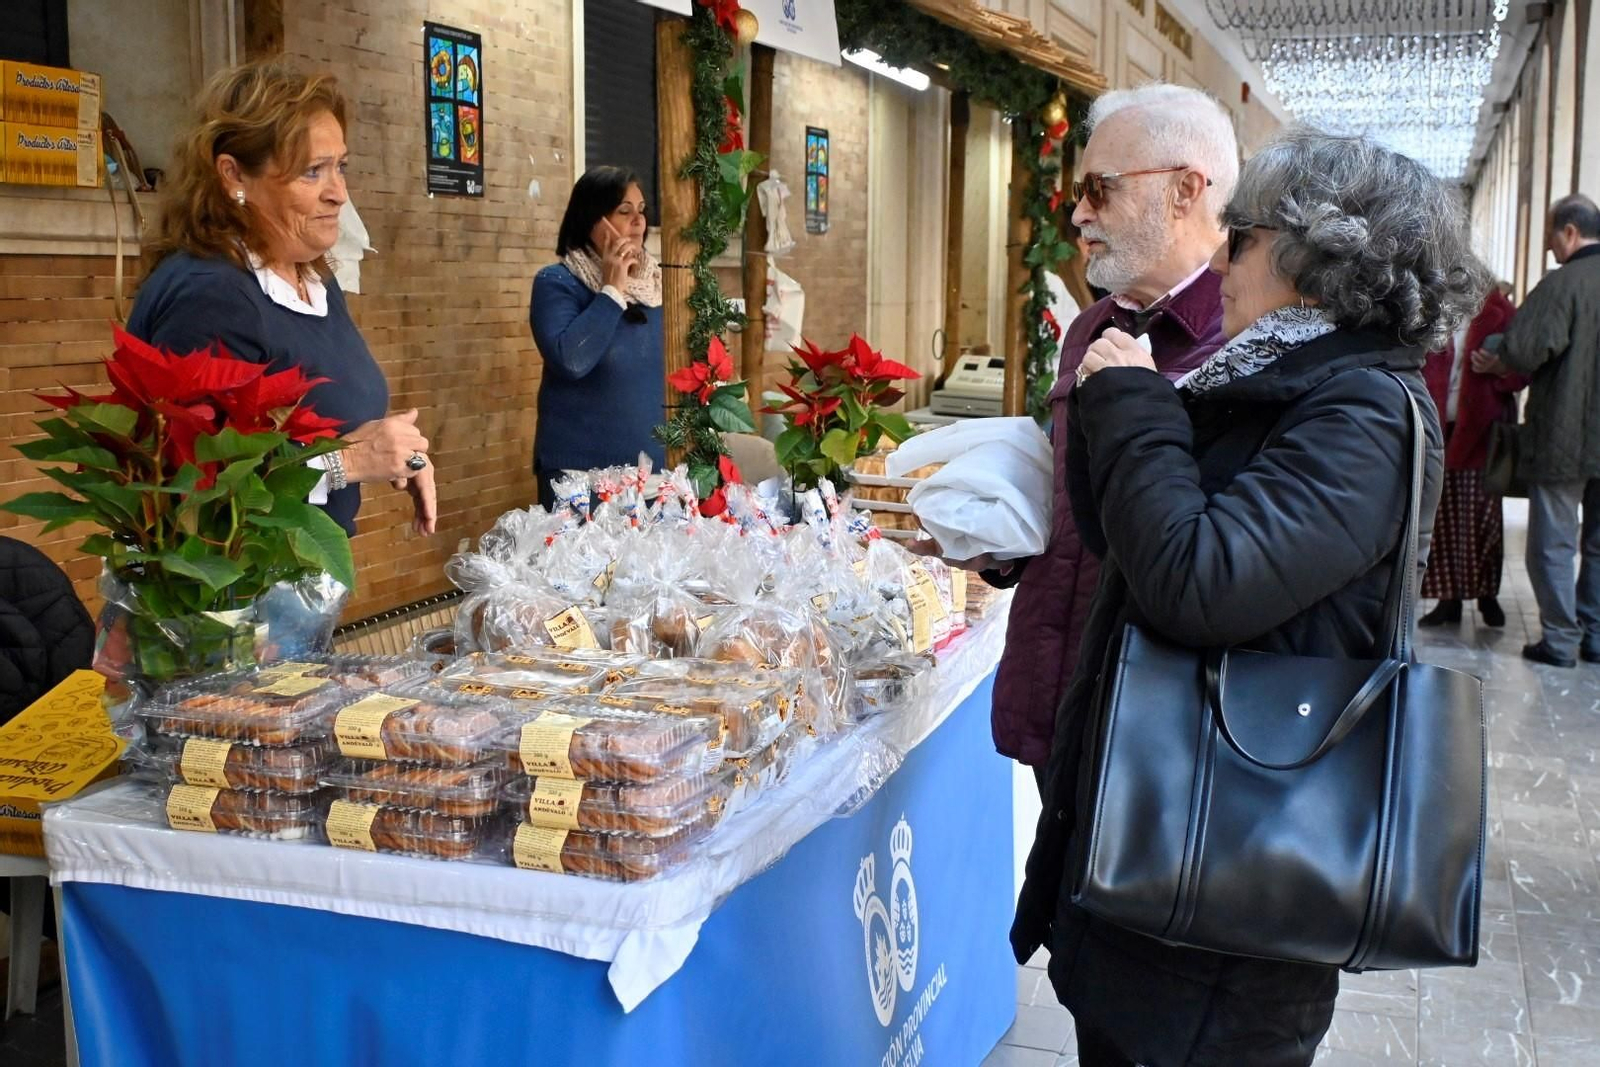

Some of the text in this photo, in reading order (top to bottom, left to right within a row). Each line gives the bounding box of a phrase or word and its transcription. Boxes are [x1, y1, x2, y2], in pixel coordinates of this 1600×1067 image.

[16, 71, 54, 90] Productos
[18, 132, 55, 149] Productos
[534, 798, 555, 806] VILLA
[903, 962, 948, 1048] PROVINCIAL
